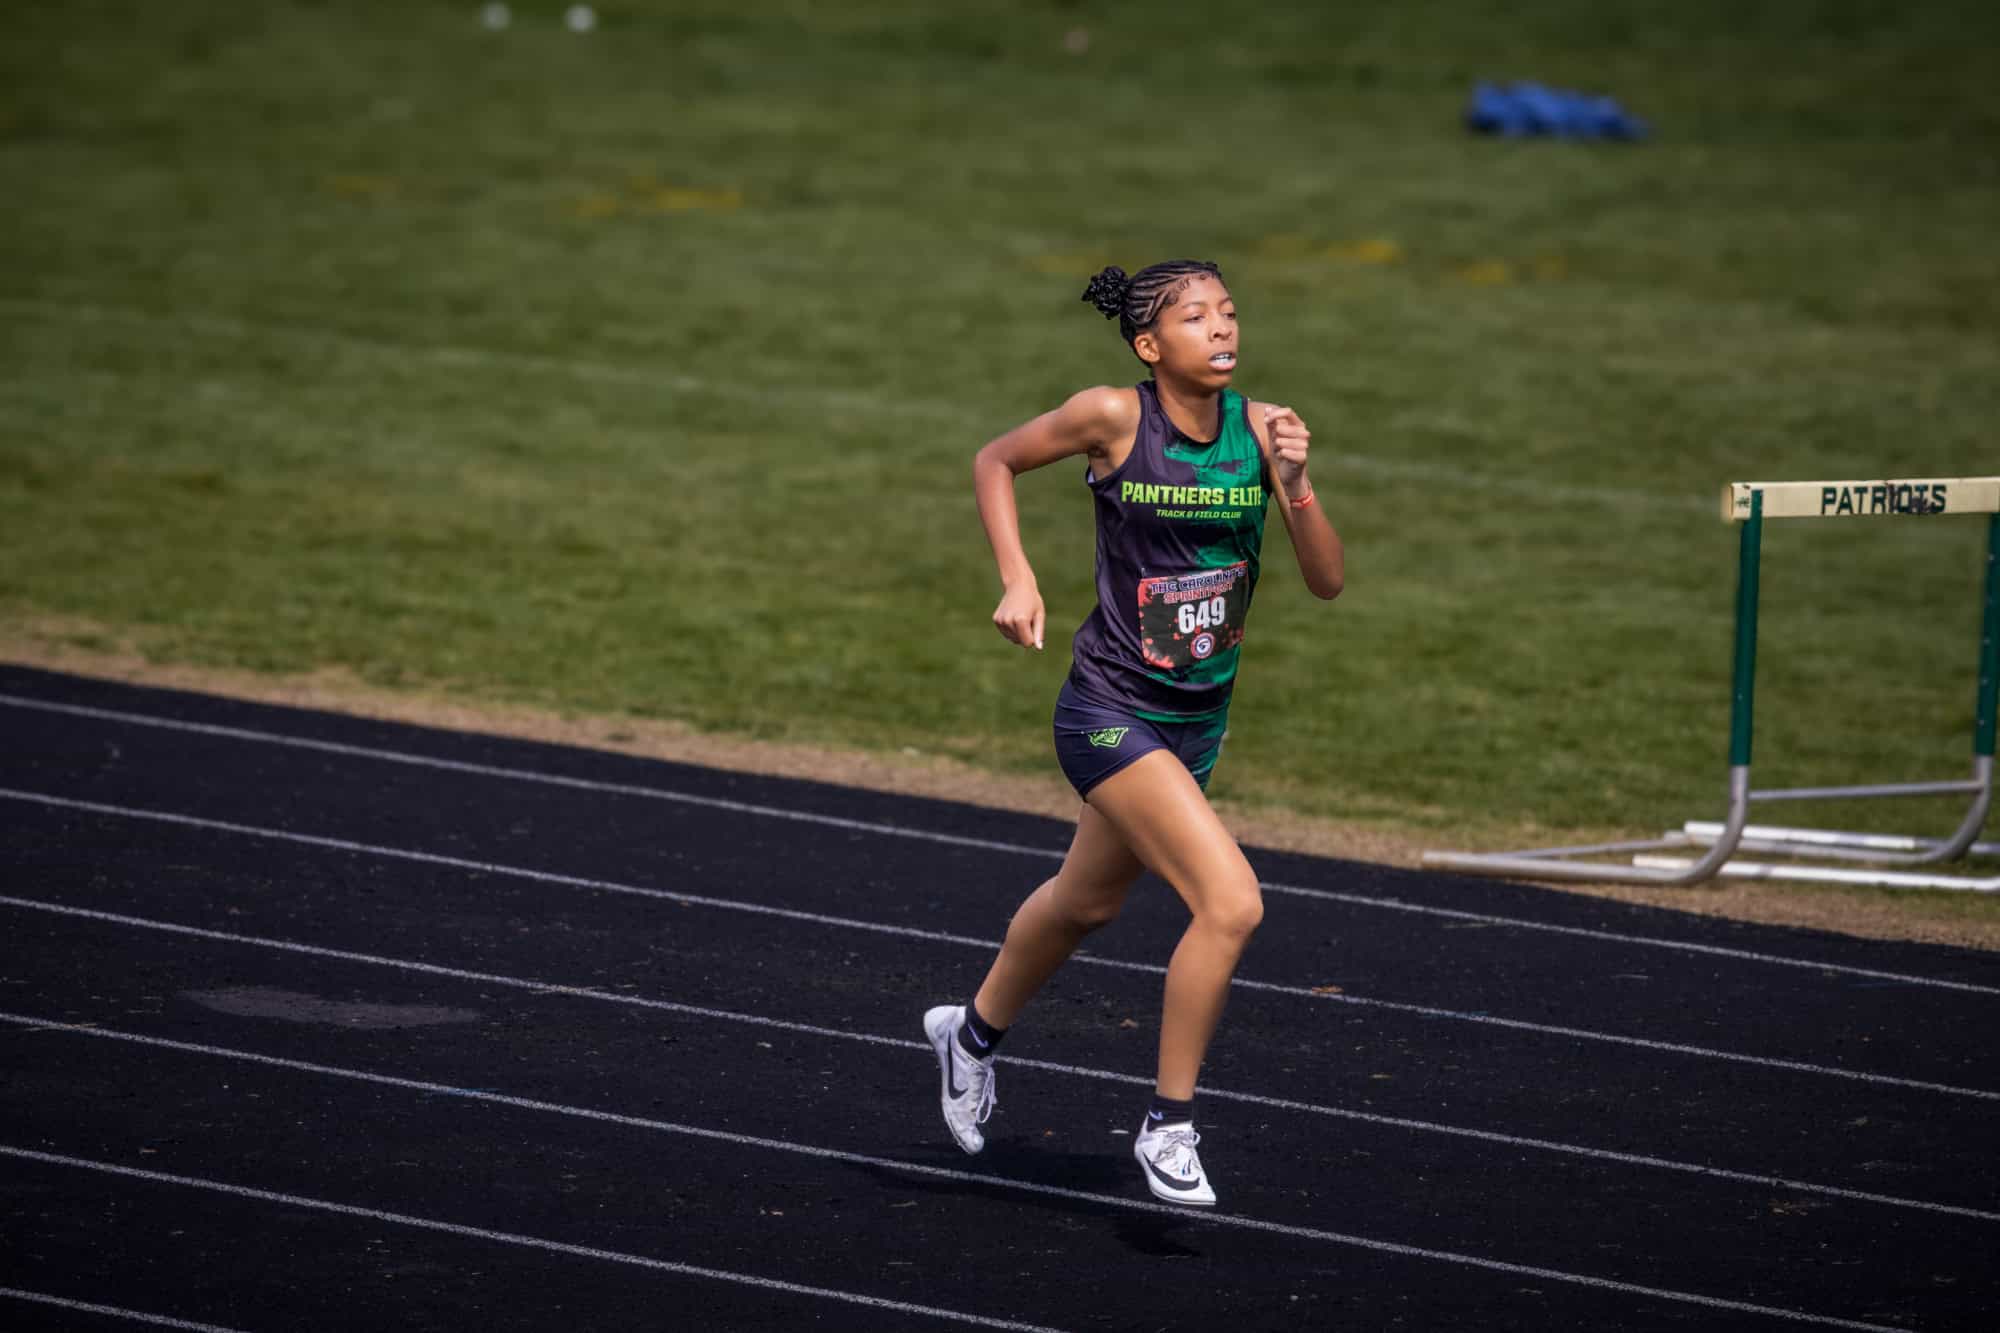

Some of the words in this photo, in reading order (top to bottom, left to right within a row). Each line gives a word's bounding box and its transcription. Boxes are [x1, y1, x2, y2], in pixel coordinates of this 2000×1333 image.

[1122, 482, 1224, 505] PANTHERS
[1822, 485, 1946, 515] PATRIOTS
[1156, 508, 1186, 518] TRACK
[1194, 510, 1220, 519] FIELD
[1178, 596, 1225, 634] 649
